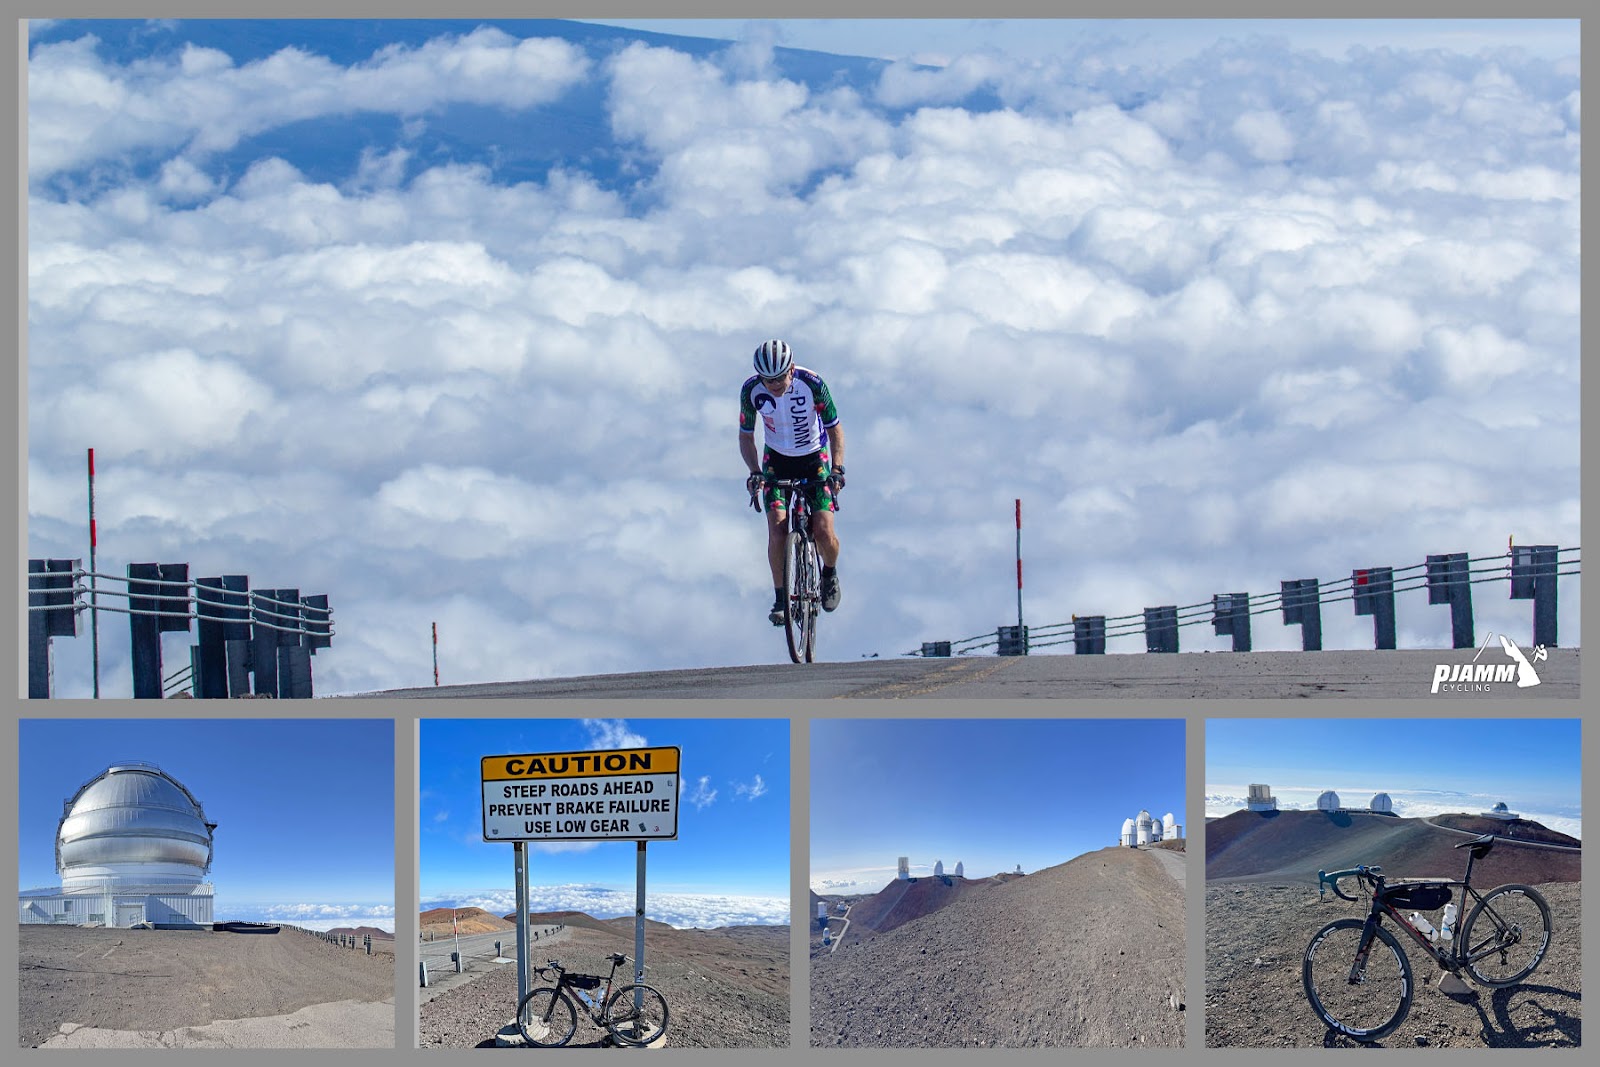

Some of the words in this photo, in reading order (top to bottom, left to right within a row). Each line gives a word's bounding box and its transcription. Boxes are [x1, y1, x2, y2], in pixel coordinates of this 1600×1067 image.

[790, 396, 810, 448] PJAMM
[505, 753, 651, 775] CAUTION
[503, 784, 546, 799] STEEP
[551, 782, 599, 797] ROADS
[603, 780, 654, 796] AHEAD
[489, 802, 552, 817] PREVENT
[556, 801, 604, 815] BRAKE
[609, 799, 671, 814] FAILURE
[525, 821, 552, 834] USE
[556, 820, 586, 833] LOW
[591, 819, 630, 833] GEAR
